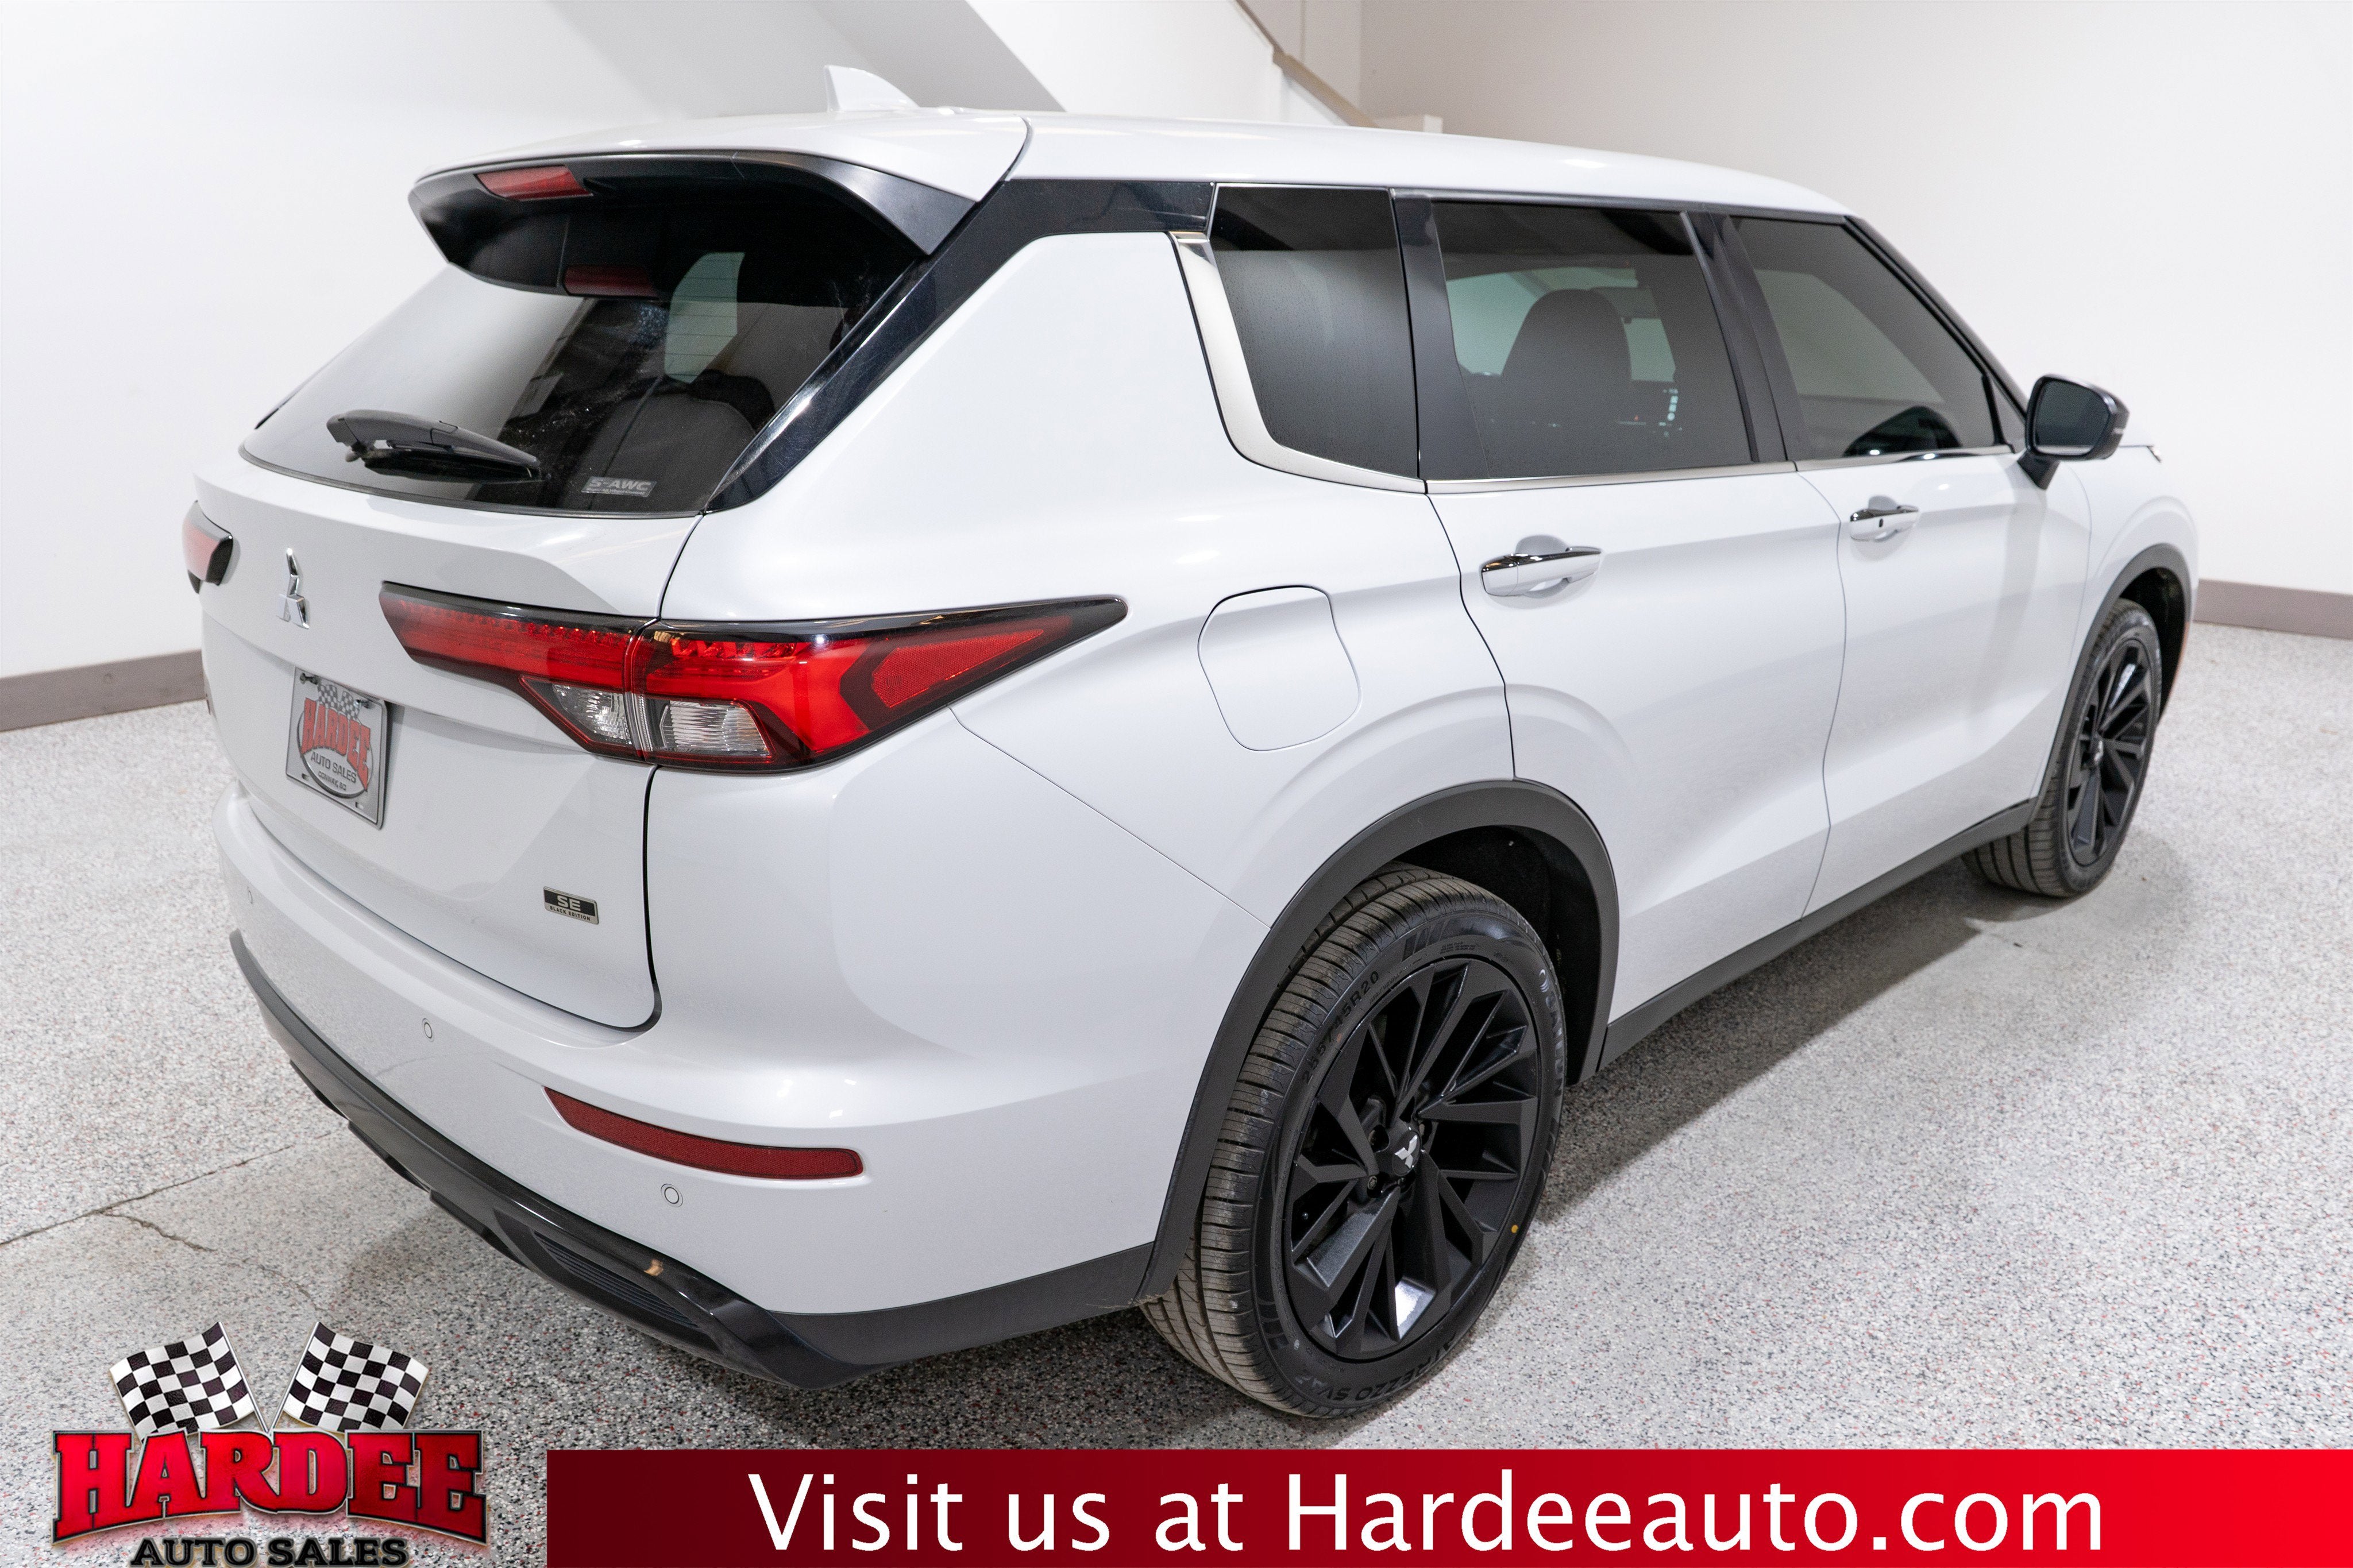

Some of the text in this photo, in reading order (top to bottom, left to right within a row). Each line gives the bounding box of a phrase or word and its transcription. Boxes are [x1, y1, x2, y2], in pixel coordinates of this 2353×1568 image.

[589, 478, 651, 491] S-AWC
[300, 697, 371, 791] HARDEE
[311, 751, 356, 783] AUTO SALES
[557, 895, 581, 912] SE
[550, 905, 591, 921] BLACK EDITION
